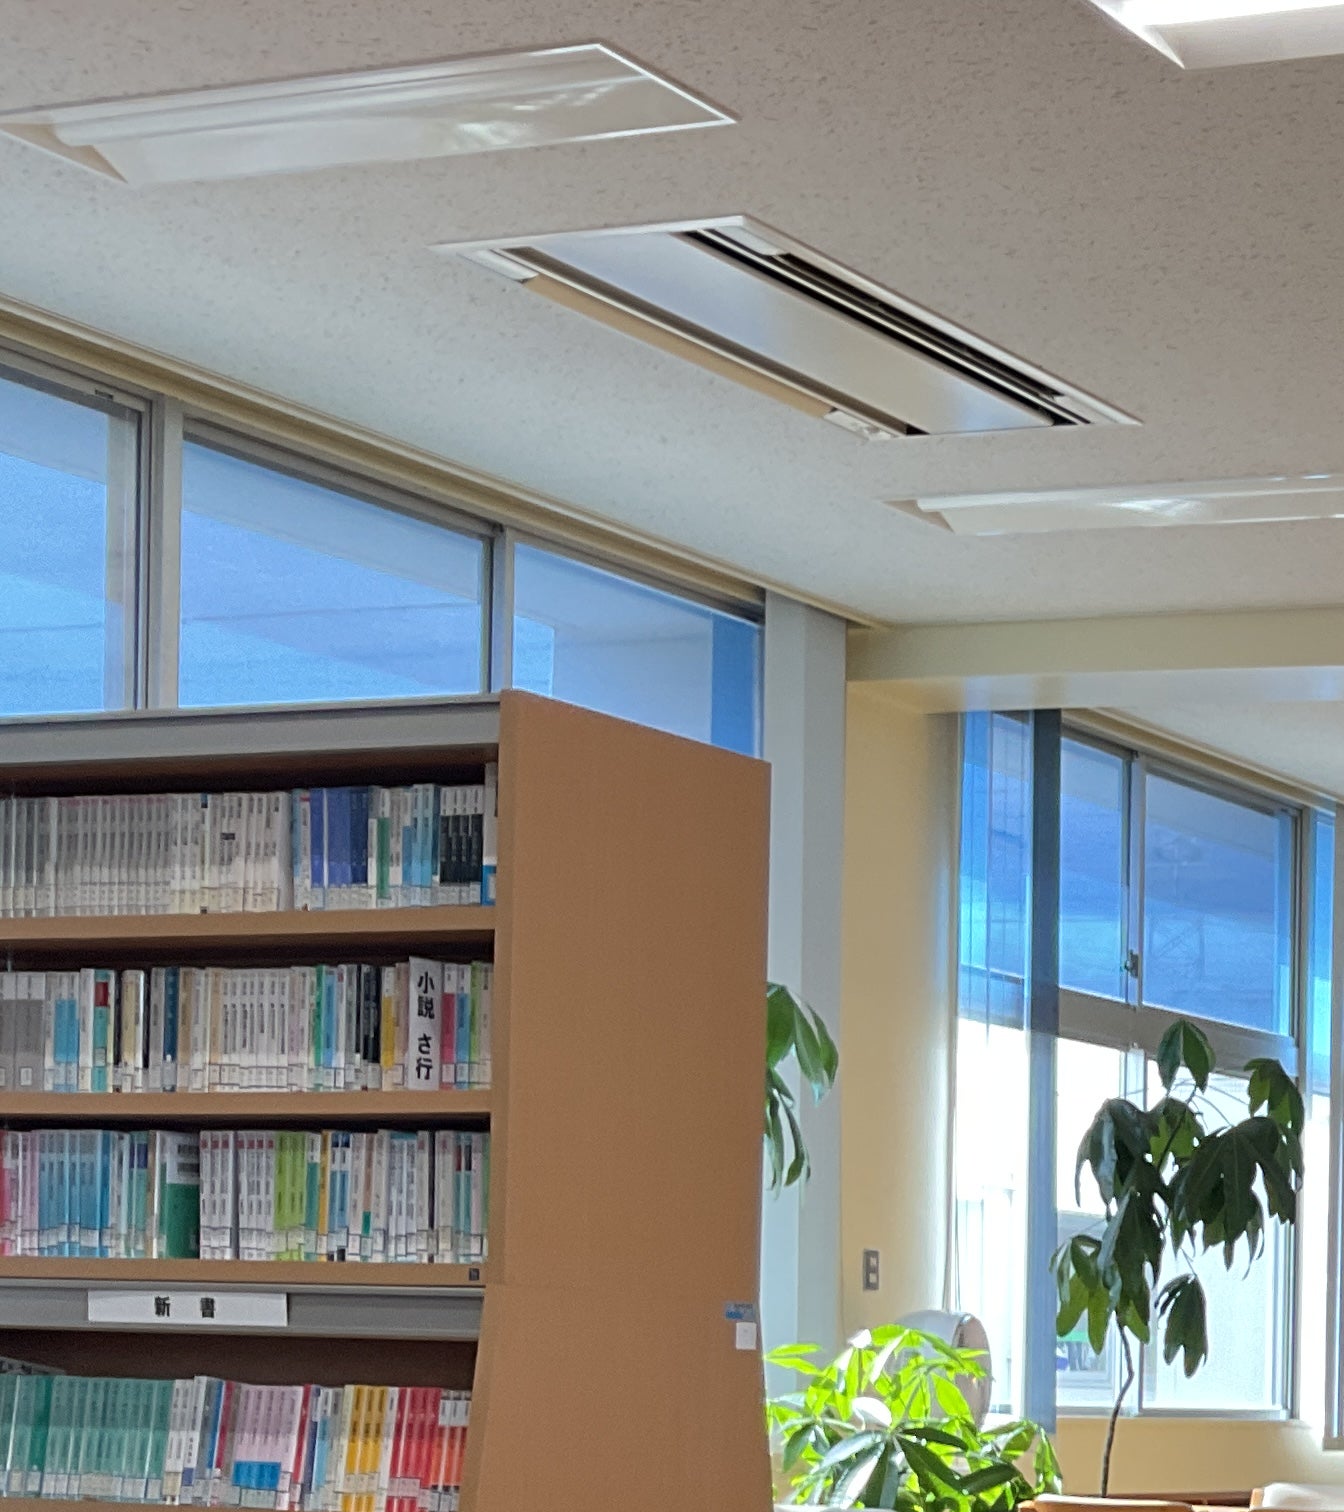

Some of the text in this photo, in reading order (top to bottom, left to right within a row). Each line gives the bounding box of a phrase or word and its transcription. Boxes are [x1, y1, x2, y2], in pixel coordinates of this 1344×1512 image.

[415, 970, 436, 1081] 小説 さ行
[154, 1295, 216, 1319] 新書
